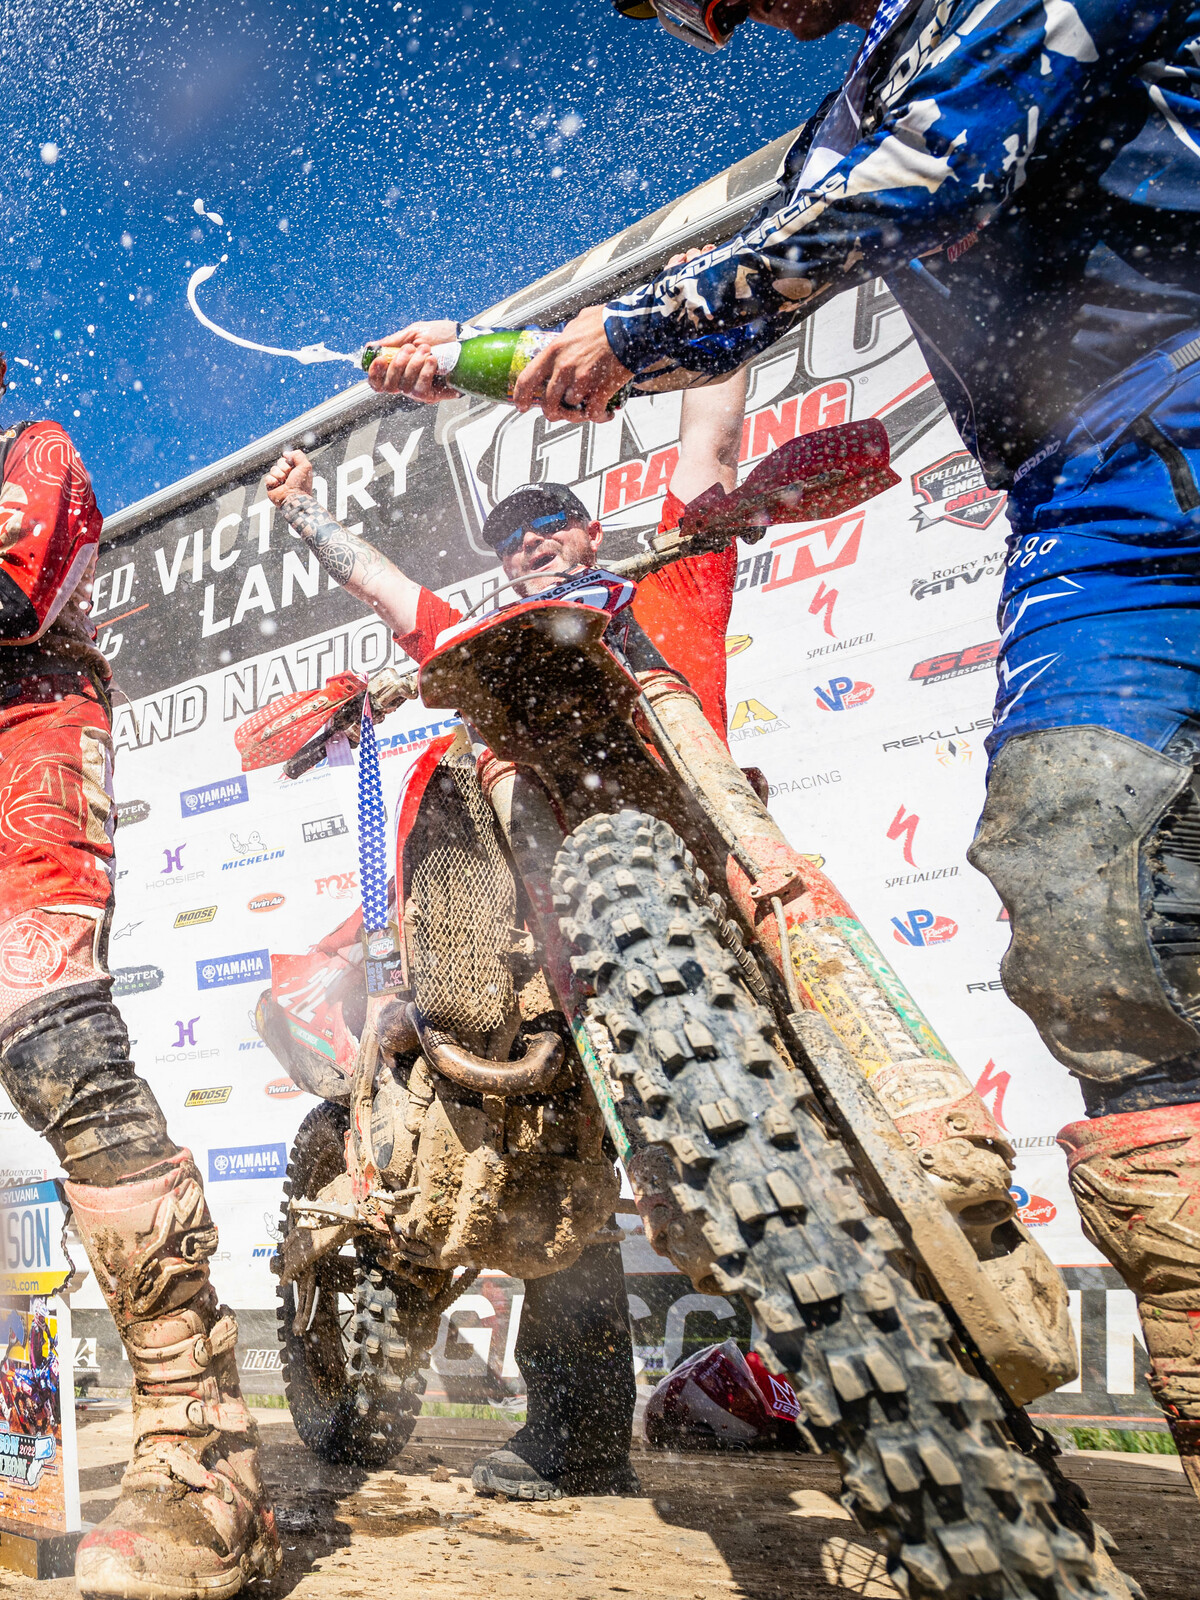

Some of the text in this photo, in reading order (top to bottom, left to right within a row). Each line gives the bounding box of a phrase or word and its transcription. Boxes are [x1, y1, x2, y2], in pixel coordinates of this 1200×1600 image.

[154, 427, 425, 595] VICTRY
[932, 559, 979, 580] ROCKY
[806, 632, 874, 660] SPECIALIZED
[813, 676, 854, 712] VP
[191, 795, 240, 811] RACING
[197, 782, 242, 804] YAMAHA
[222, 849, 286, 871] MICHELIN
[146, 870, 206, 890] HOOSIER
[315, 870, 359, 896] FOX
[884, 865, 959, 889] SPECIALIZED
[249, 896, 285, 911] Twin Air
[177, 907, 215, 923] MOOSE
[890, 909, 934, 947] VP
[924, 921, 958, 941] Racing
[207, 970, 261, 984] RACING
[215, 957, 264, 977] YAMAHA
[155, 1048, 220, 1064] HOOSIER
[189, 1088, 229, 1101] MOOSE
[267, 1083, 289, 1095] Twin
[228, 1150, 280, 1169] YAMAHA
[0, 1168, 43, 1177] MOUNTAIN
[219, 1166, 278, 1175] RACING
[19, 1444, 36, 1457] 2022
